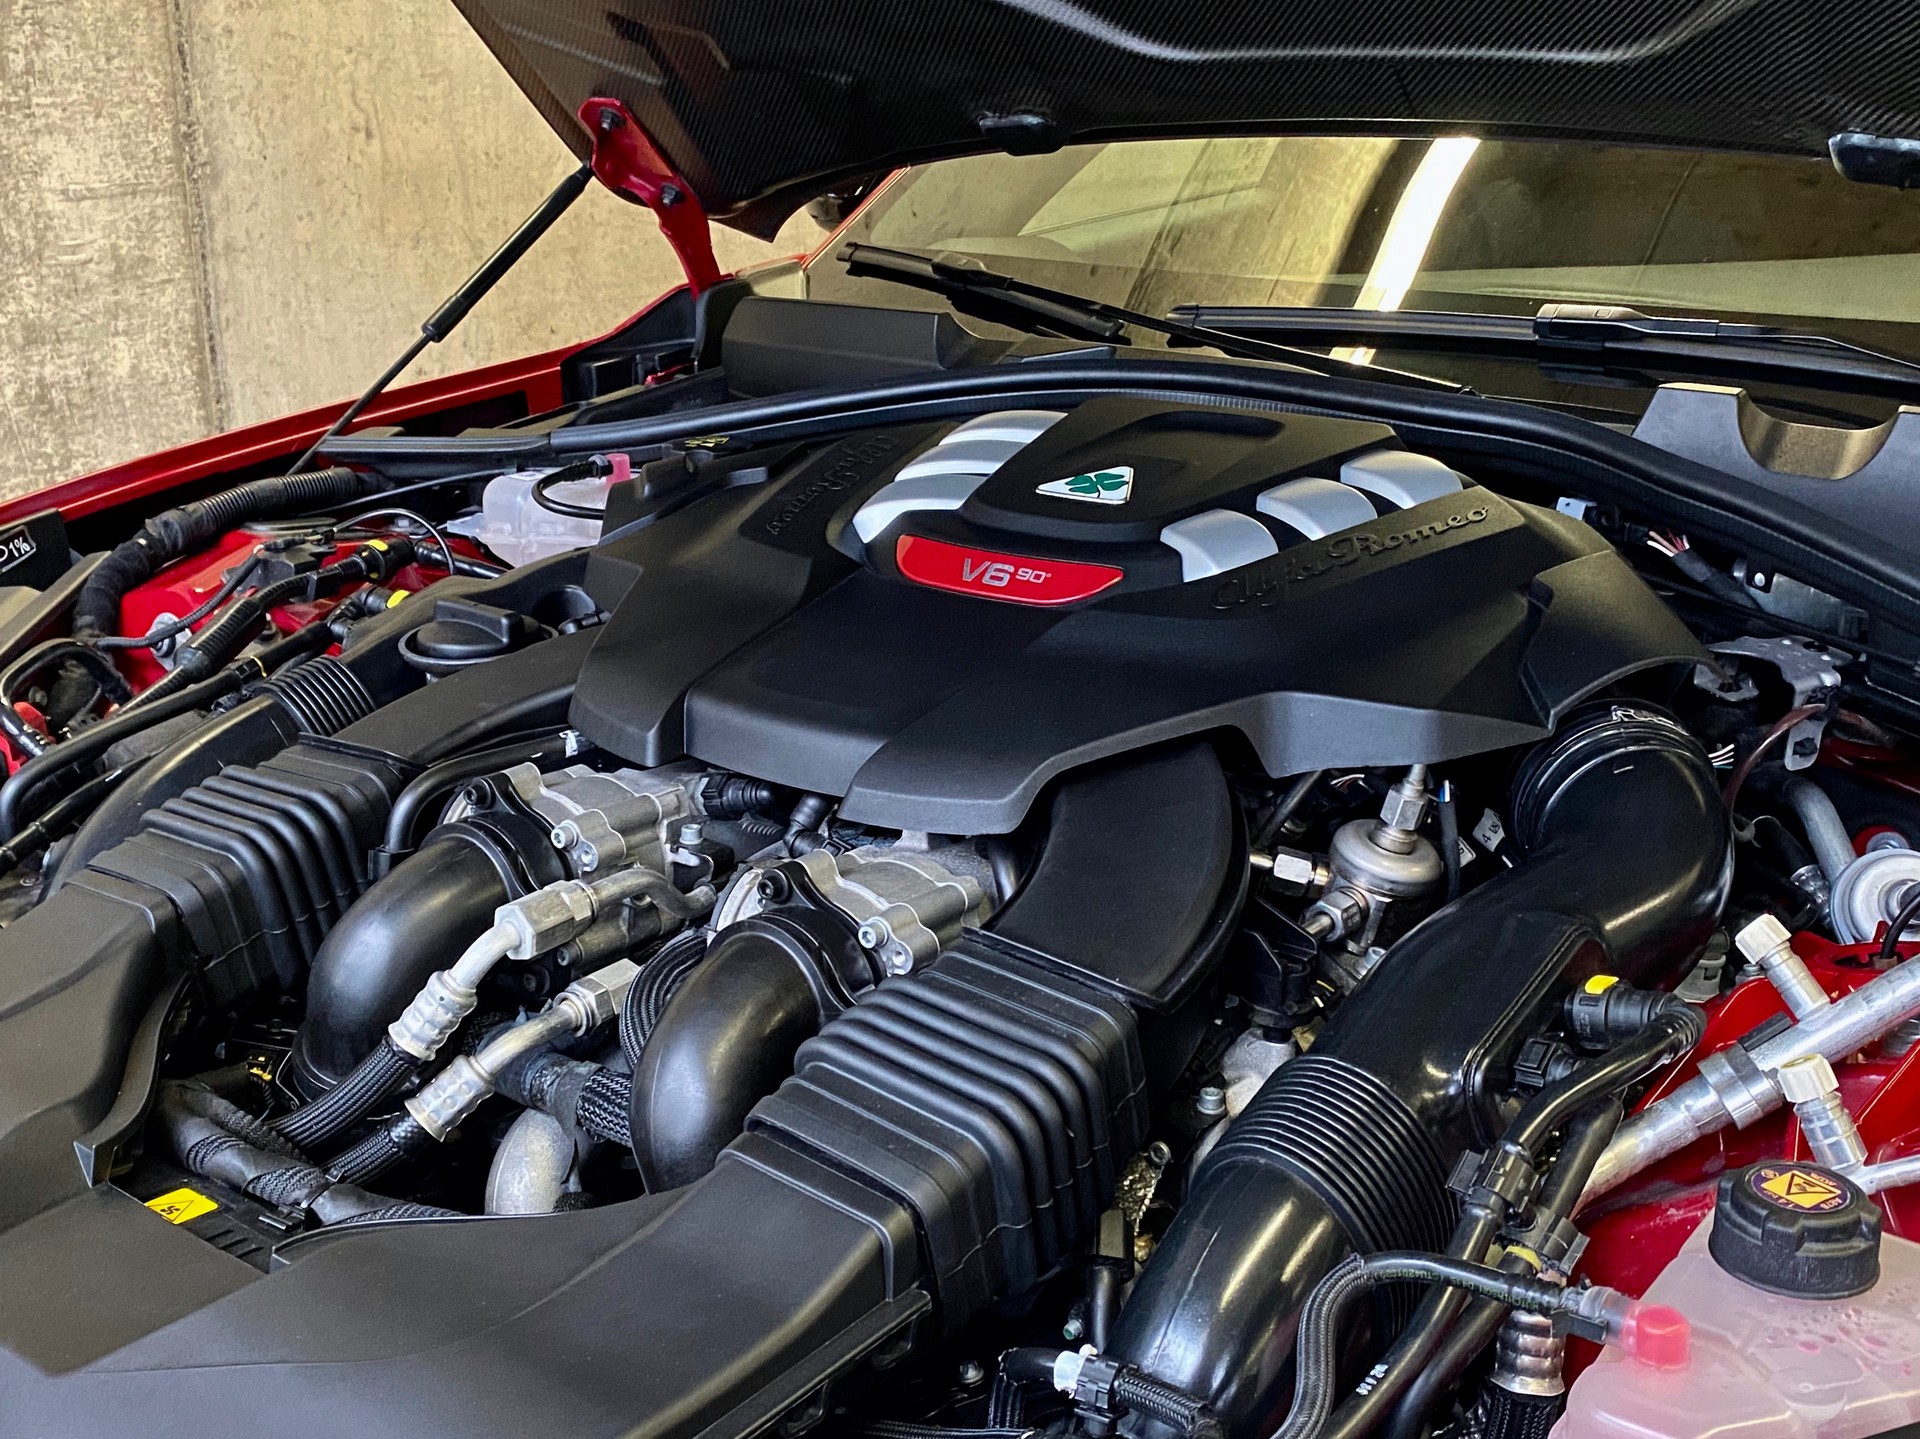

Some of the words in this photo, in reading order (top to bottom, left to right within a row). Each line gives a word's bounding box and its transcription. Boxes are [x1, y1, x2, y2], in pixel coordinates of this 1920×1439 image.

[962, 558, 1015, 587] V6
[1211, 556, 1332, 610] Alfa
[1328, 506, 1489, 567] Romeo
